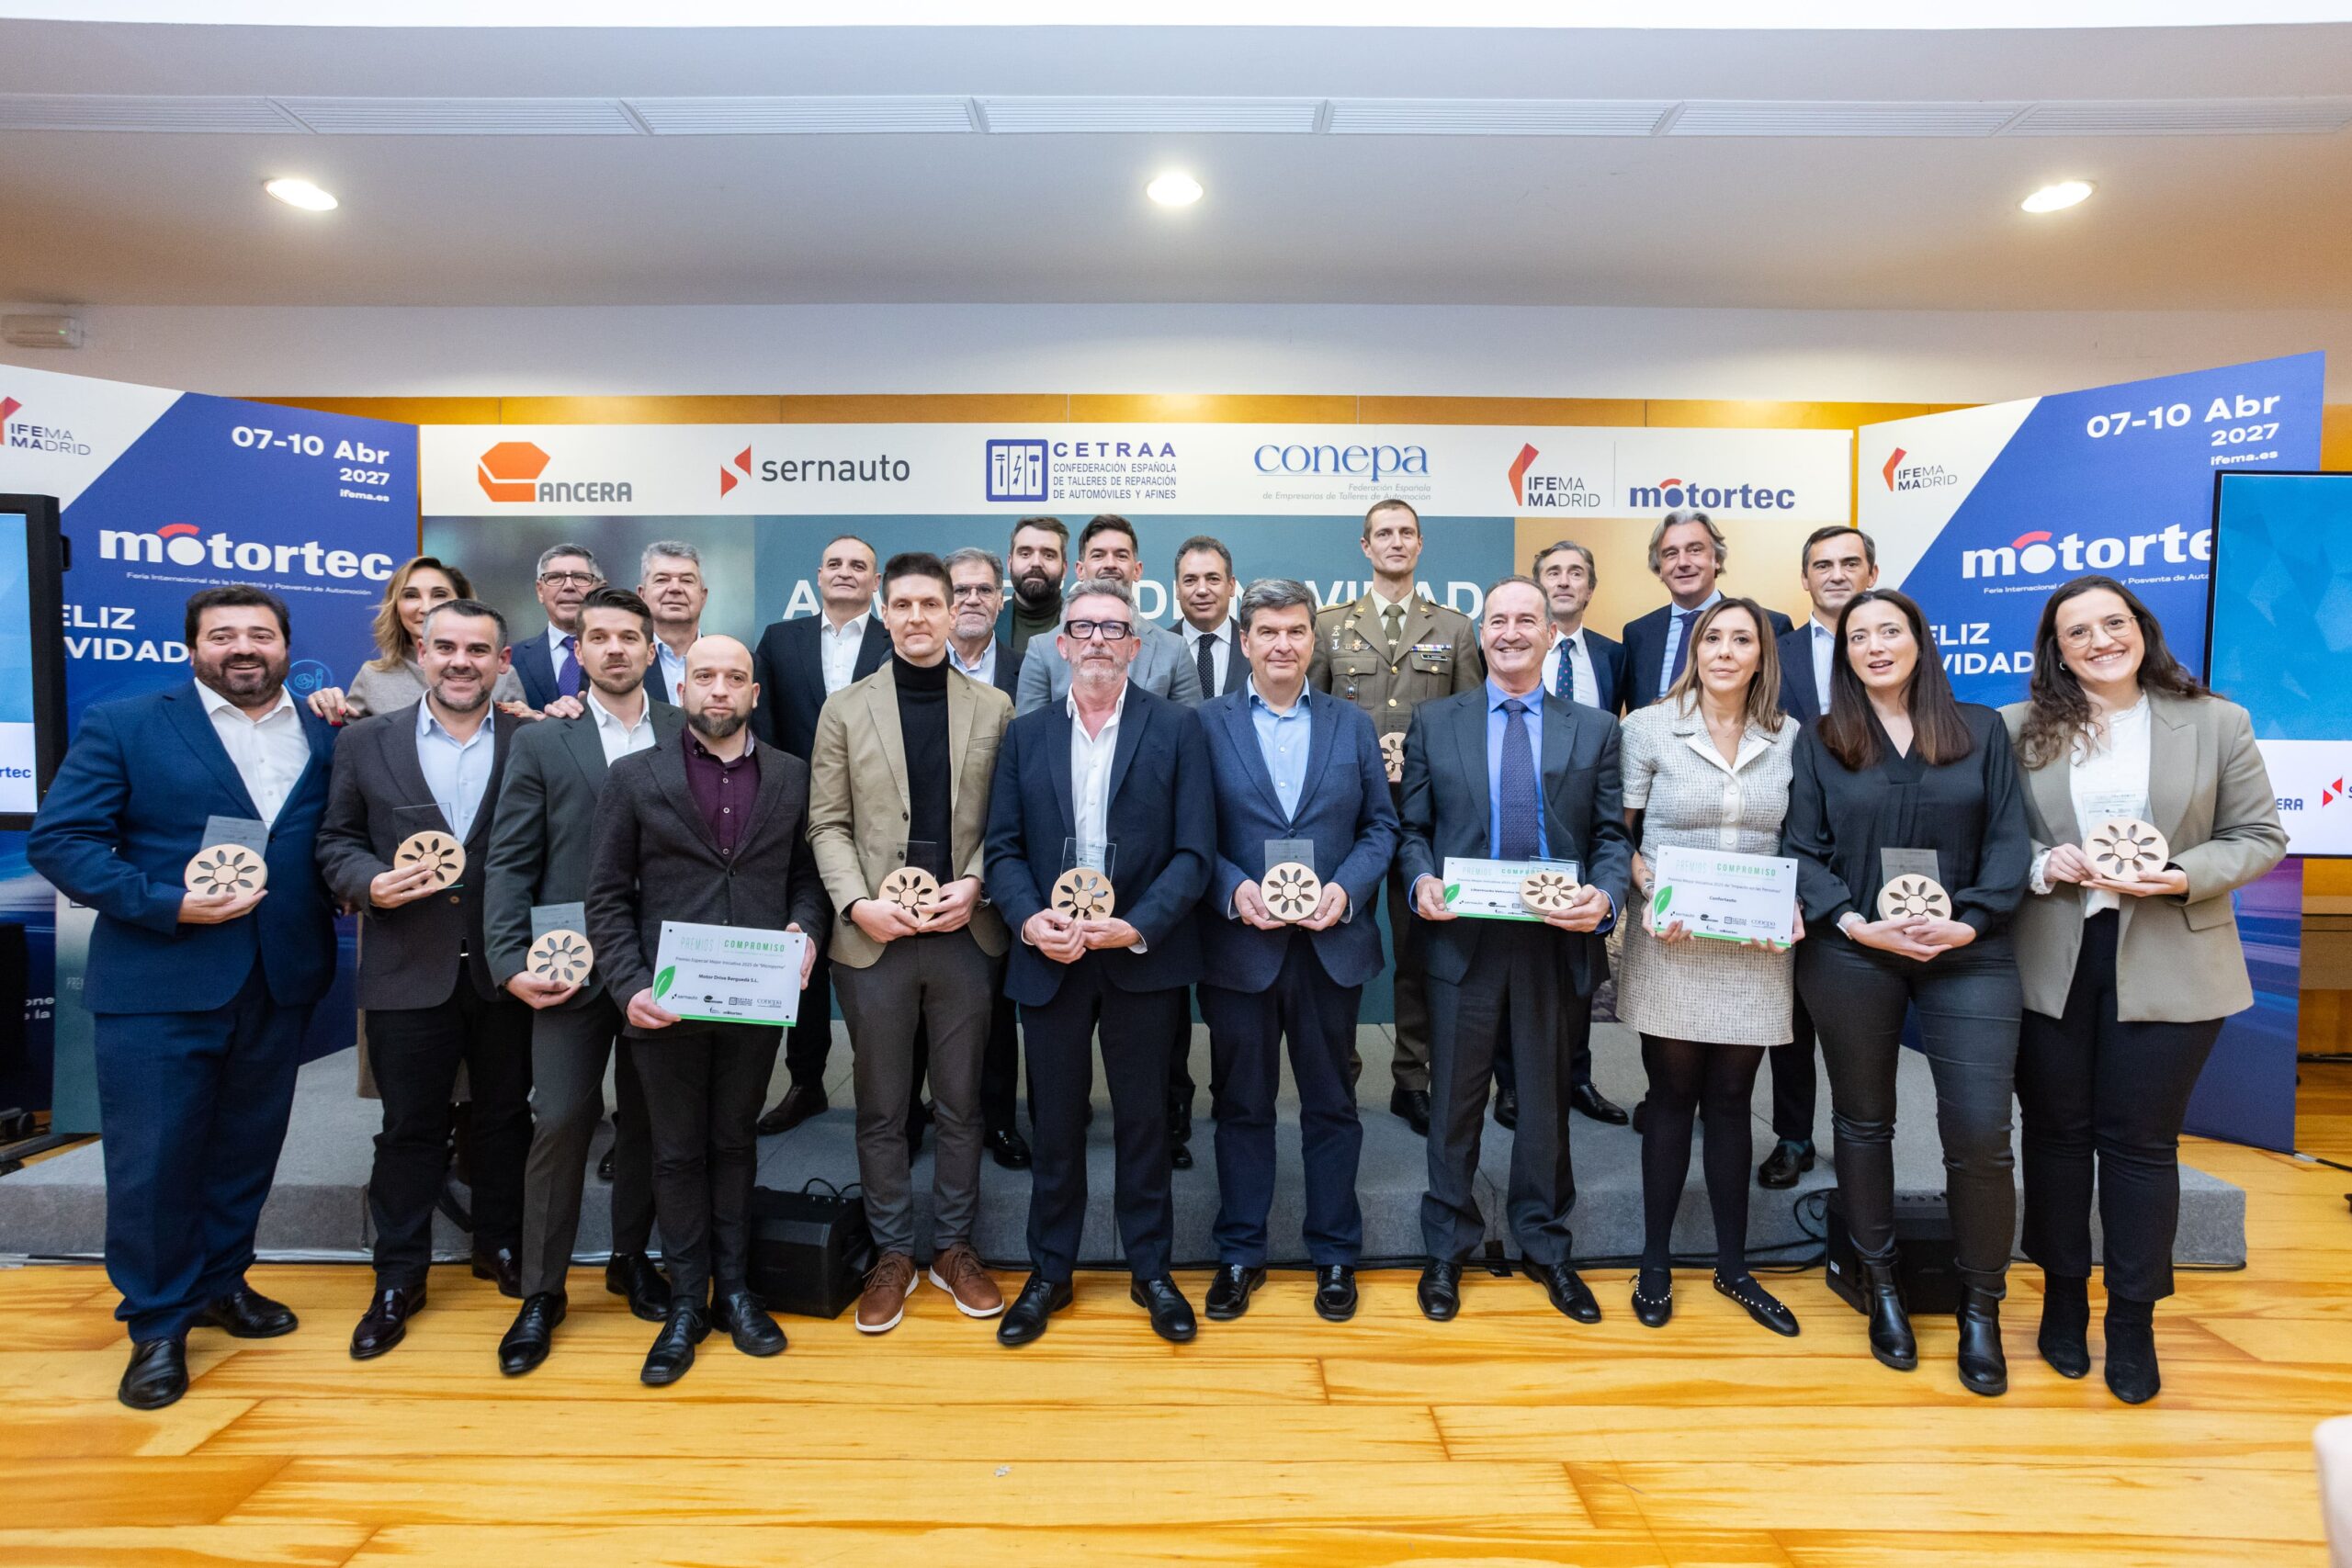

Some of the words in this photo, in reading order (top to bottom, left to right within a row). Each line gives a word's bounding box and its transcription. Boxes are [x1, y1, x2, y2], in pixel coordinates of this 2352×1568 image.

[2086, 403, 2191, 438] 07-10
[2203, 393, 2280, 423] Abr
[11, 423, 74, 441] IFEMA
[2211, 423, 2280, 446] 2027
[11, 435, 91, 456] MADRID
[232, 426, 324, 456] 07-10
[334, 440, 390, 465] Abr
[1053, 442, 1177, 457] CETRAA
[1254, 445, 1429, 482] conepa
[2211, 449, 2278, 466] ifema.es
[761, 454, 911, 483] sernauto
[1053, 461, 1126, 473] CONFEDERACIÓN
[1131, 461, 1177, 473] ESPAÑOLA
[1897, 464, 1945, 479] IFEMA
[339, 468, 390, 486] 2027
[1053, 476, 1064, 486] DE
[1068, 476, 1107, 486] TALLERES
[1111, 476, 1122, 486] DE
[1125, 475, 1177, 486] REPARACIÓN
[1528, 476, 1585, 491] IFEMA
[1897, 473, 1958, 491] MADRID
[339, 489, 390, 502] ifema.es
[538, 481, 633, 502] ANCERA
[1053, 489, 1065, 499] DE
[1069, 488, 1131, 499] AUTOMÓVILES
[1136, 489, 1141, 499] Y
[1145, 489, 1177, 500] AFINES
[1262, 491, 1273, 501] de
[1326, 492, 1337, 501] de
[1370, 492, 1381, 501] de
[1528, 492, 1600, 507] MADRID
[1630, 481, 1795, 510] motortec
[99, 526, 393, 581] motortec
[1962, 524, 2212, 579] motorte
[2005, 582, 2057, 593] Internacional
[2128, 576, 2172, 585] Posventa
[63, 637, 190, 663] VIDAD
[1717, 863, 1776, 876] COMPROMISO
[724, 940, 786, 953] COMPROMISO
